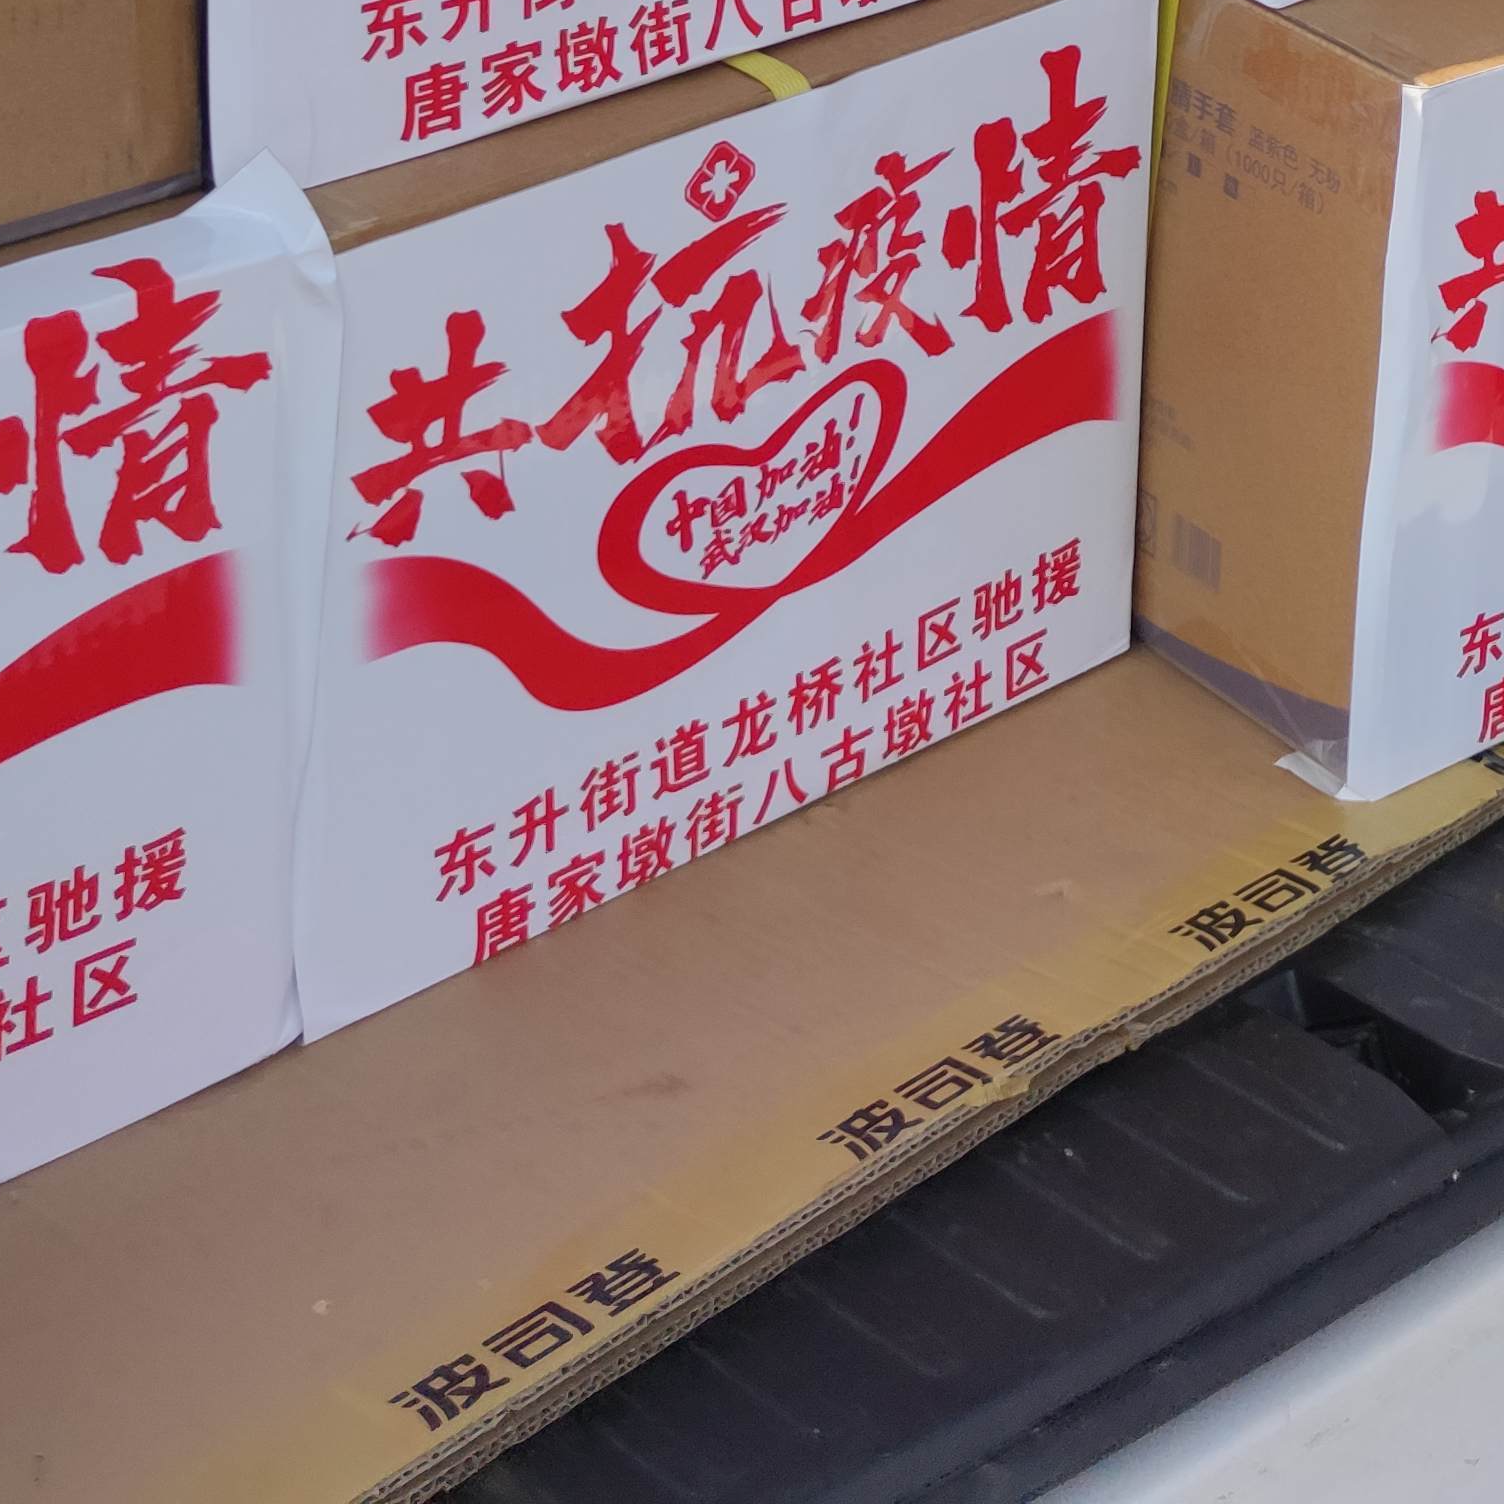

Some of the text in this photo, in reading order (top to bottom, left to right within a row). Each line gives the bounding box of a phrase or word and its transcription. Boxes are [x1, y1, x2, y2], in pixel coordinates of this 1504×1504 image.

[350, 44, 1141, 547] 共抗疫情
[435, 539, 1080, 900] 东升街道龙桥社区驰援
[471, 629, 1048, 970] 唐家墩街八古墩社区
[816, 1013, 1062, 1160] 波司登
[388, 1247, 681, 1432] 波司登
